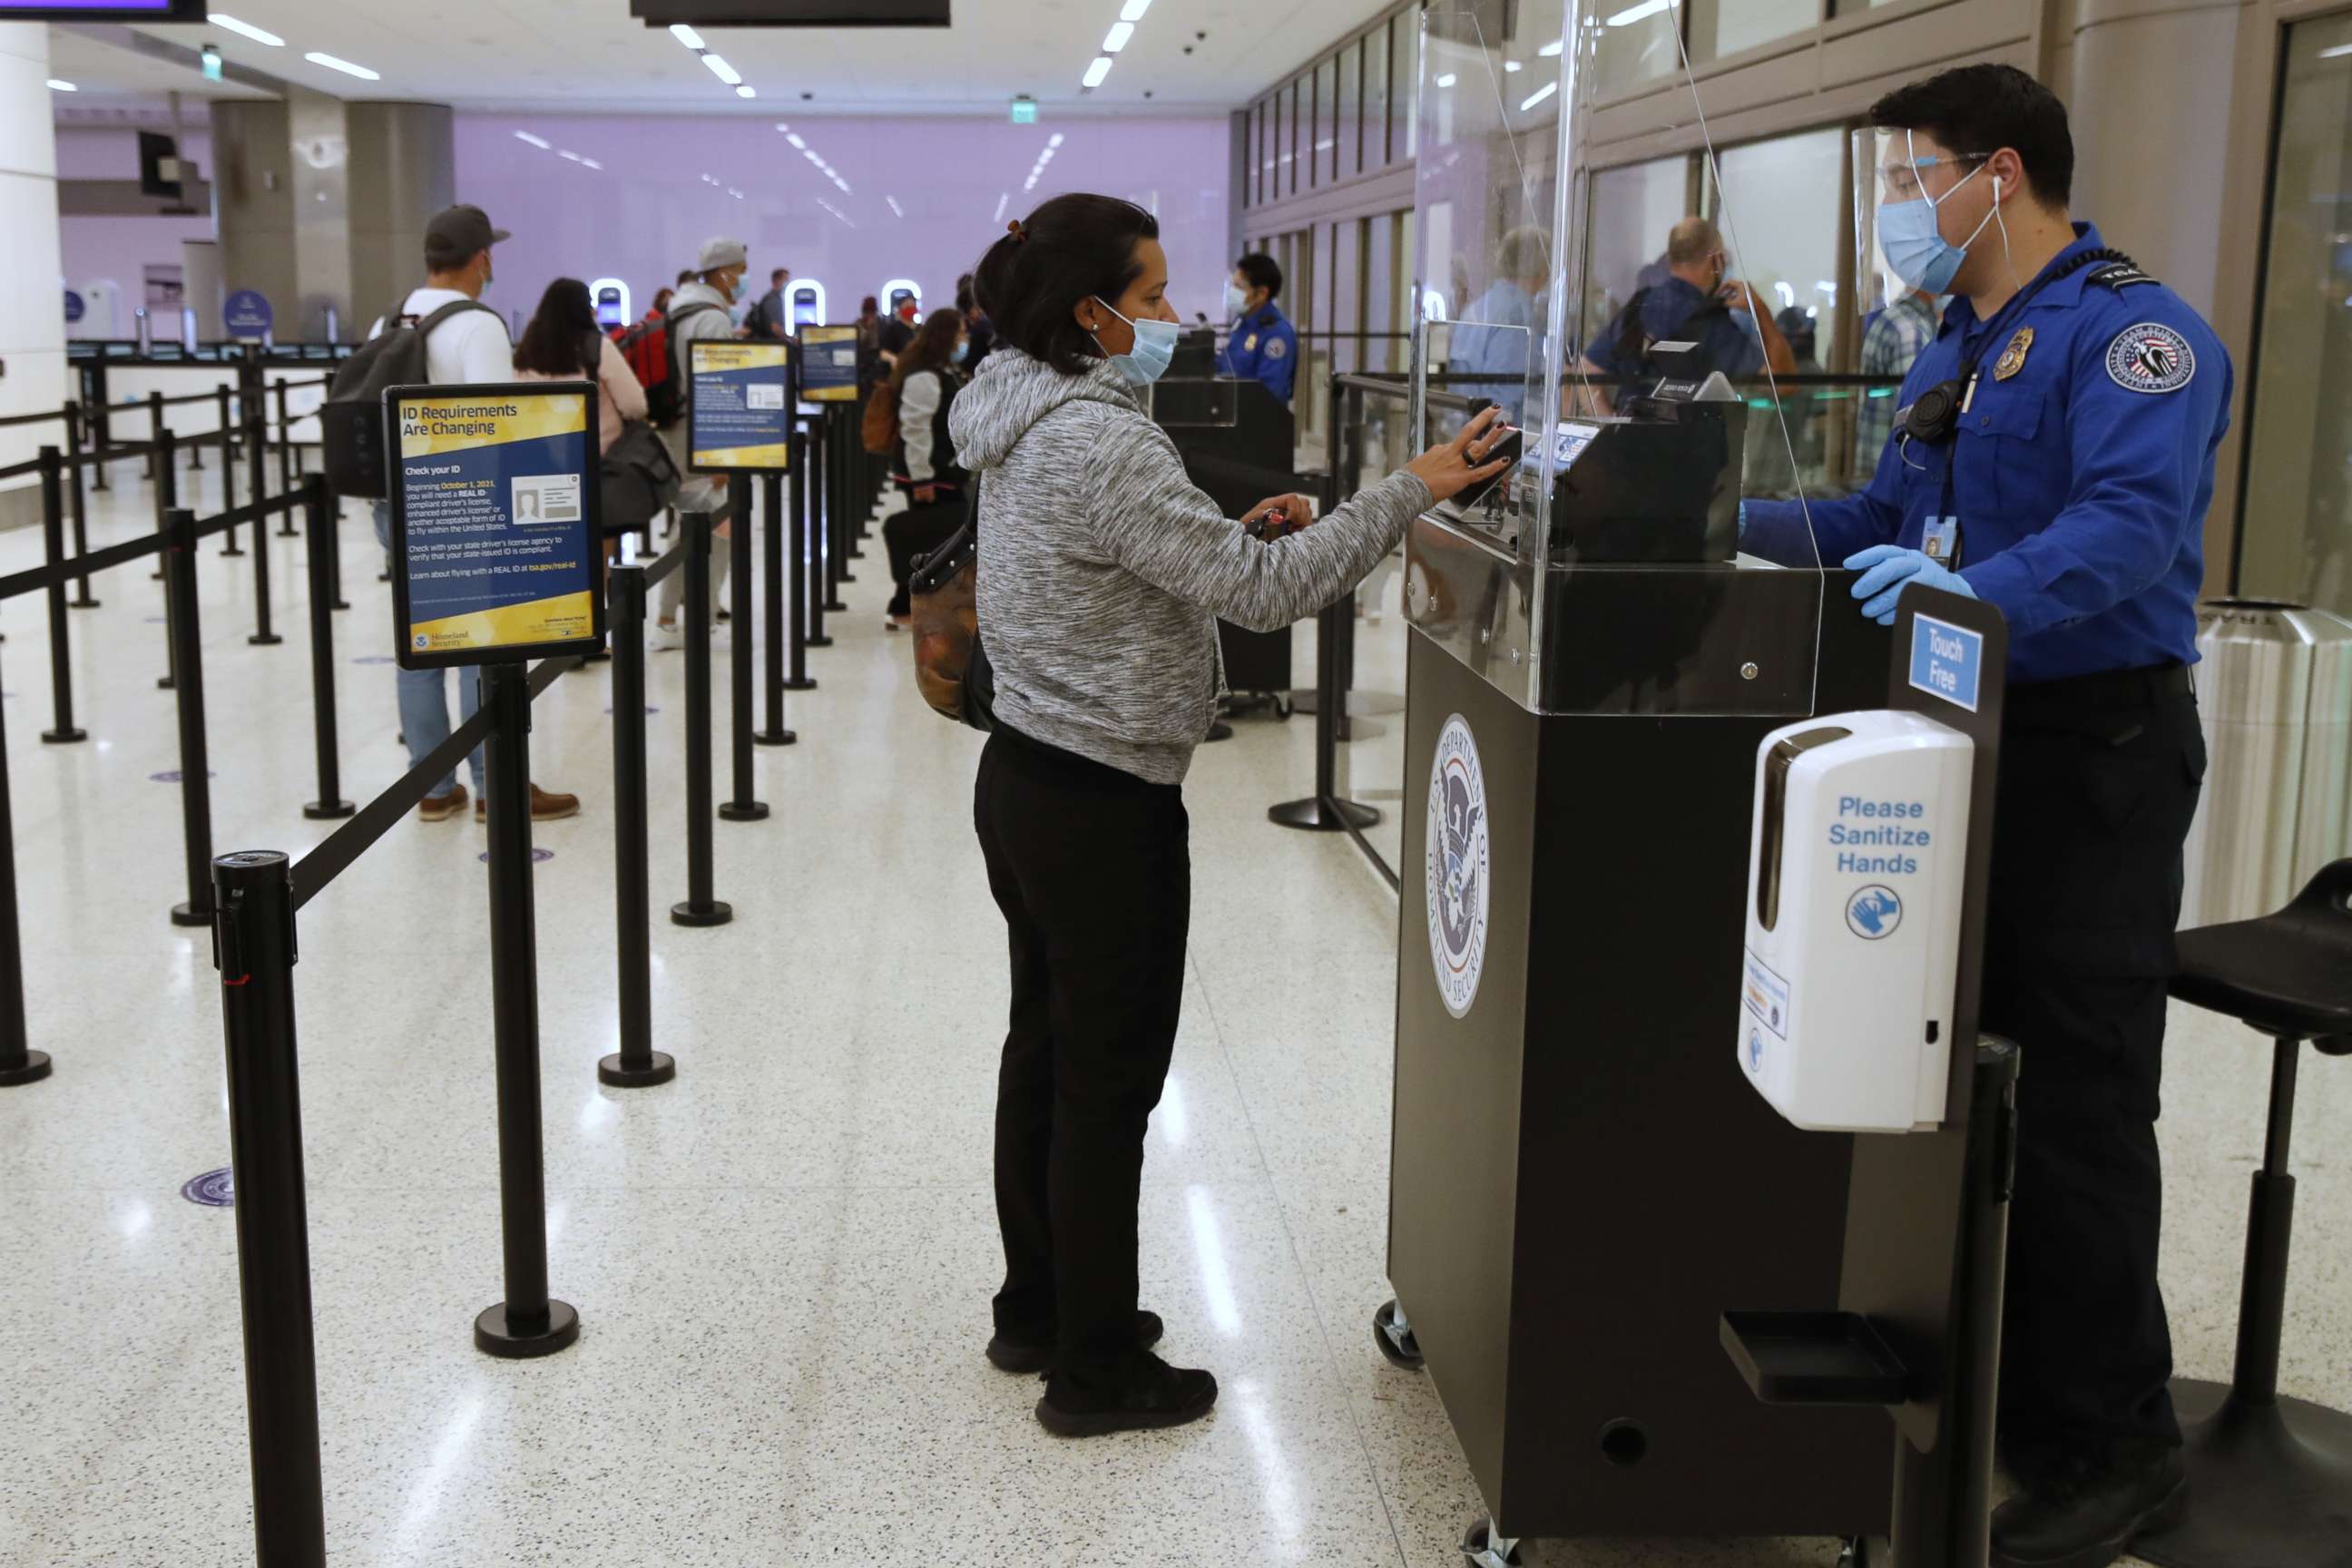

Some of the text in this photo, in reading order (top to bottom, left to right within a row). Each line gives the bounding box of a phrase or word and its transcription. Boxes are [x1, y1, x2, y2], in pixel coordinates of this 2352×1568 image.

[403, 404, 517, 420] ID Requirements
[404, 420, 495, 436] Are Changing
[405, 465, 460, 475] Check your ID
[441, 481, 467, 490] October
[407, 493, 420, 501] you
[458, 489, 476, 497] REAL
[407, 500, 440, 509] compliant
[407, 509, 440, 517] enhanced
[407, 518, 434, 526] another
[435, 515, 471, 524] acceptable
[472, 514, 488, 523] form
[407, 527, 416, 535] to
[416, 526, 426, 535] fly
[427, 524, 449, 534] within
[450, 524, 461, 533] the
[463, 523, 485, 532] United
[408, 554, 429, 562] verify
[446, 553, 461, 561] your
[463, 549, 503, 558] state-issued
[519, 545, 552, 554] compliant.
[430, 570, 450, 578] about
[451, 569, 471, 577] flying
[472, 567, 487, 575] with
[1929, 628, 1963, 663] Touch
[1929, 659, 1955, 692] Free
[1441, 730, 1486, 822] DEPARTMENT
[1839, 797, 1923, 818] Please
[1829, 824, 1930, 847] Sanitize
[1838, 852, 1917, 874] Hands
[1453, 911, 1484, 1003] SECURITY
